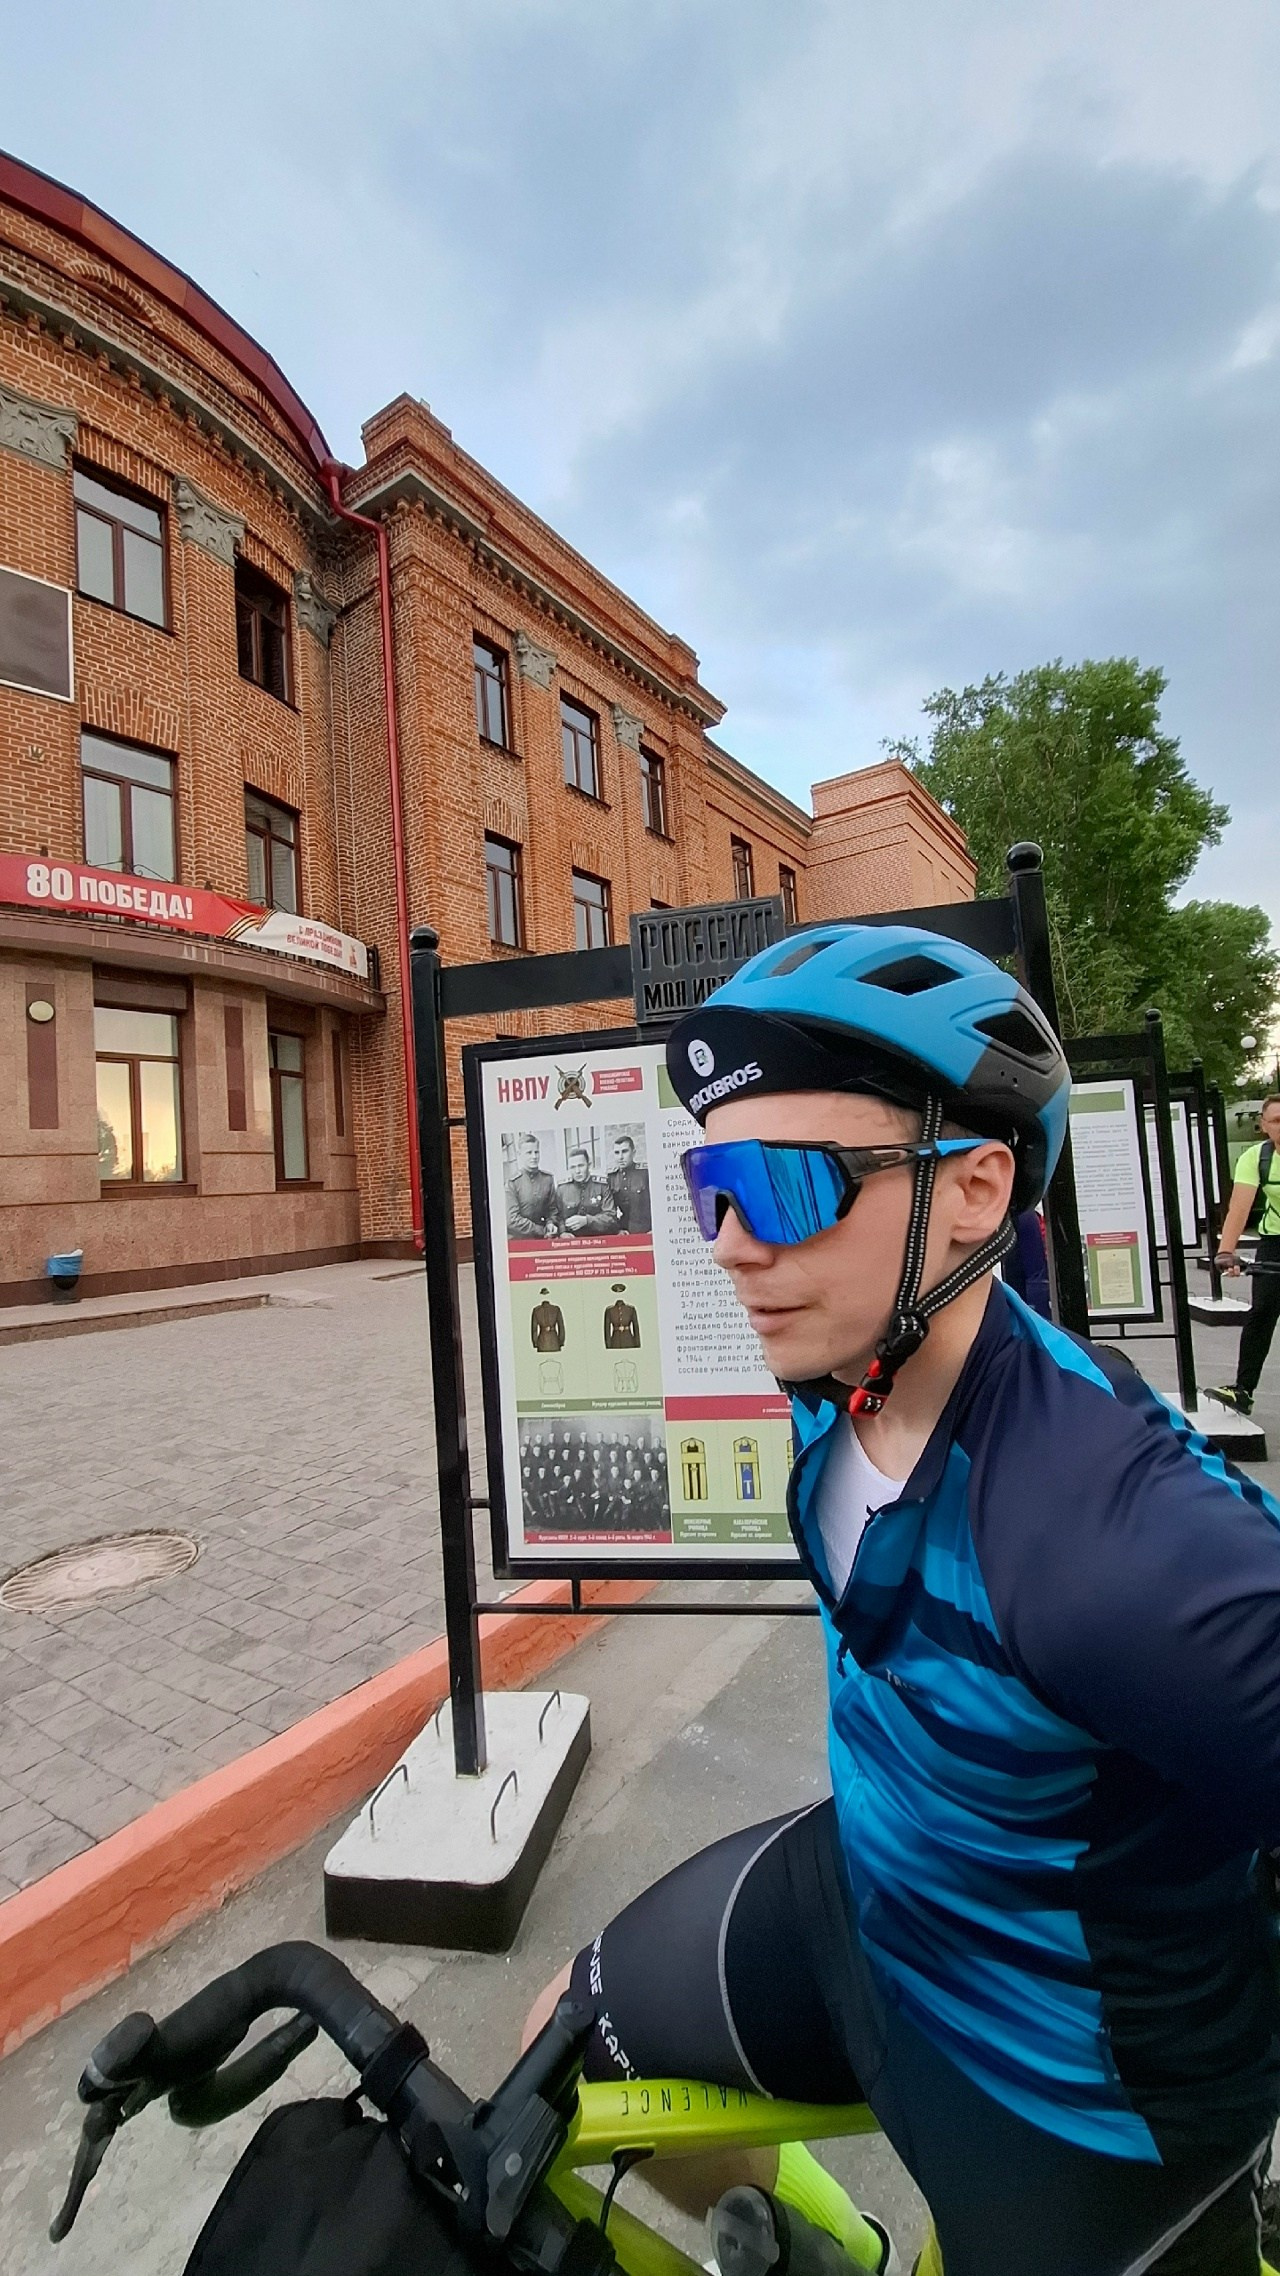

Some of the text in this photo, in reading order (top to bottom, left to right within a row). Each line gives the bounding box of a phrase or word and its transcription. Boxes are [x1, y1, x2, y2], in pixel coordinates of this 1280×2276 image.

[27, 863, 193, 920] 80 ПОБЕДА!
[638, 907, 774, 971] РОССИЯ
[643, 979, 687, 1011] МОЯ
[497, 1075, 550, 1104] НВПУ
[689, 1061, 764, 1114] ROCKBROS
[667, 1119, 692, 1128] Среди
[662, 1129, 695, 1138] военные
[662, 1141, 691, 1149] ванное
[669, 1235, 695, 1245] частей
[670, 1258, 706, 1267] большую
[694, 1268, 722, 1277] января
[672, 1279, 732, 1288] военно-пехотн
[680, 1290, 690, 1298] 20
[680, 1300, 694, 1309] 3-7
[695, 1301, 709, 1309] лет
[718, 1299, 728, 1307] 23
[683, 1311, 744, 1321] Идущие боевые
[675, 1322, 721, 1331] необходимо
[722, 1321, 743, 1329] было
[675, 1333, 760, 1342] командно-преподава
[676, 1345, 732, 1354] фронтовиками
[717, 1354, 749, 1363] довести
[678, 1366, 708, 1375] составе
[710, 1366, 740, 1375] училищ
